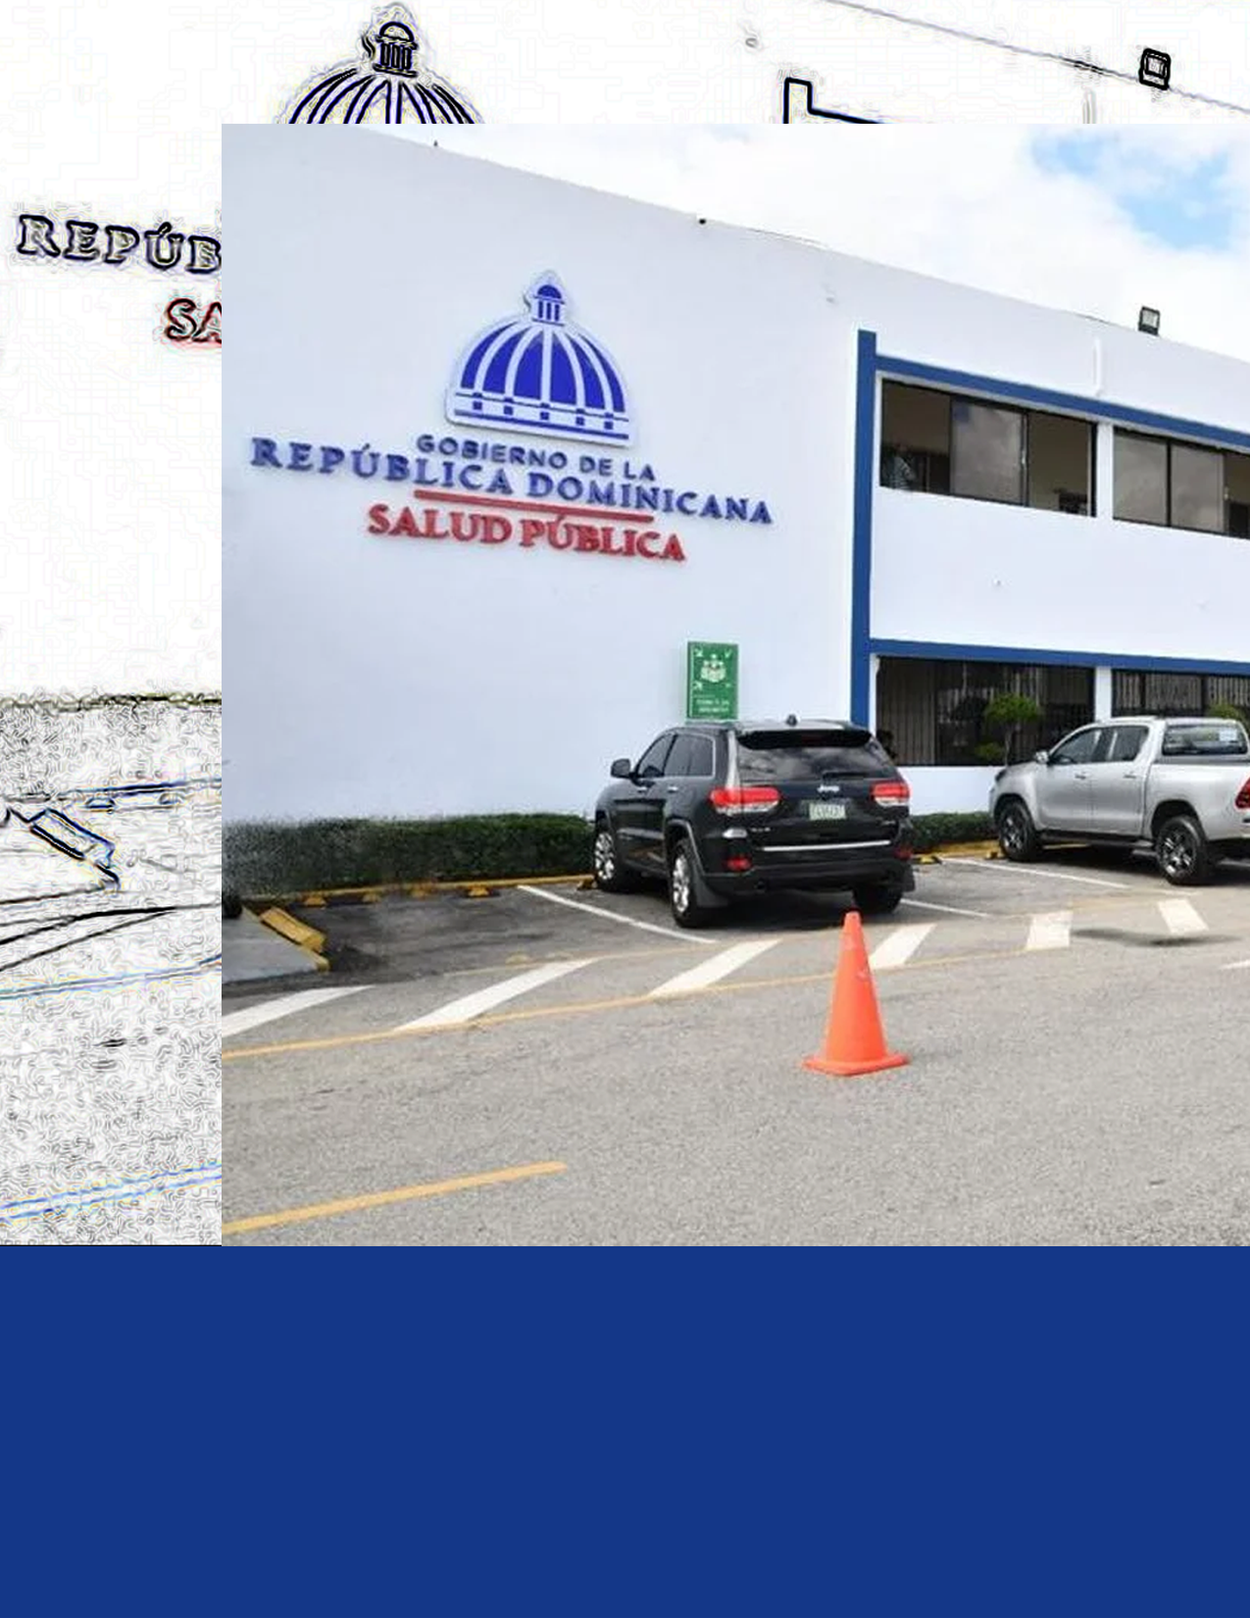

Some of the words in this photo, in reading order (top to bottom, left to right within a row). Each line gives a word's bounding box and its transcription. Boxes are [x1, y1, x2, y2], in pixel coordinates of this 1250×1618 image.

[250, 437, 514, 495] REPÚBLICA
[527, 472, 772, 524] DOMINICANA
[416, 434, 568, 469] GOBIERNO
[579, 456, 613, 476] DE
[624, 461, 656, 481] LA
[367, 503, 513, 543] SALUD
[518, 515, 686, 561] PÚBLICA
